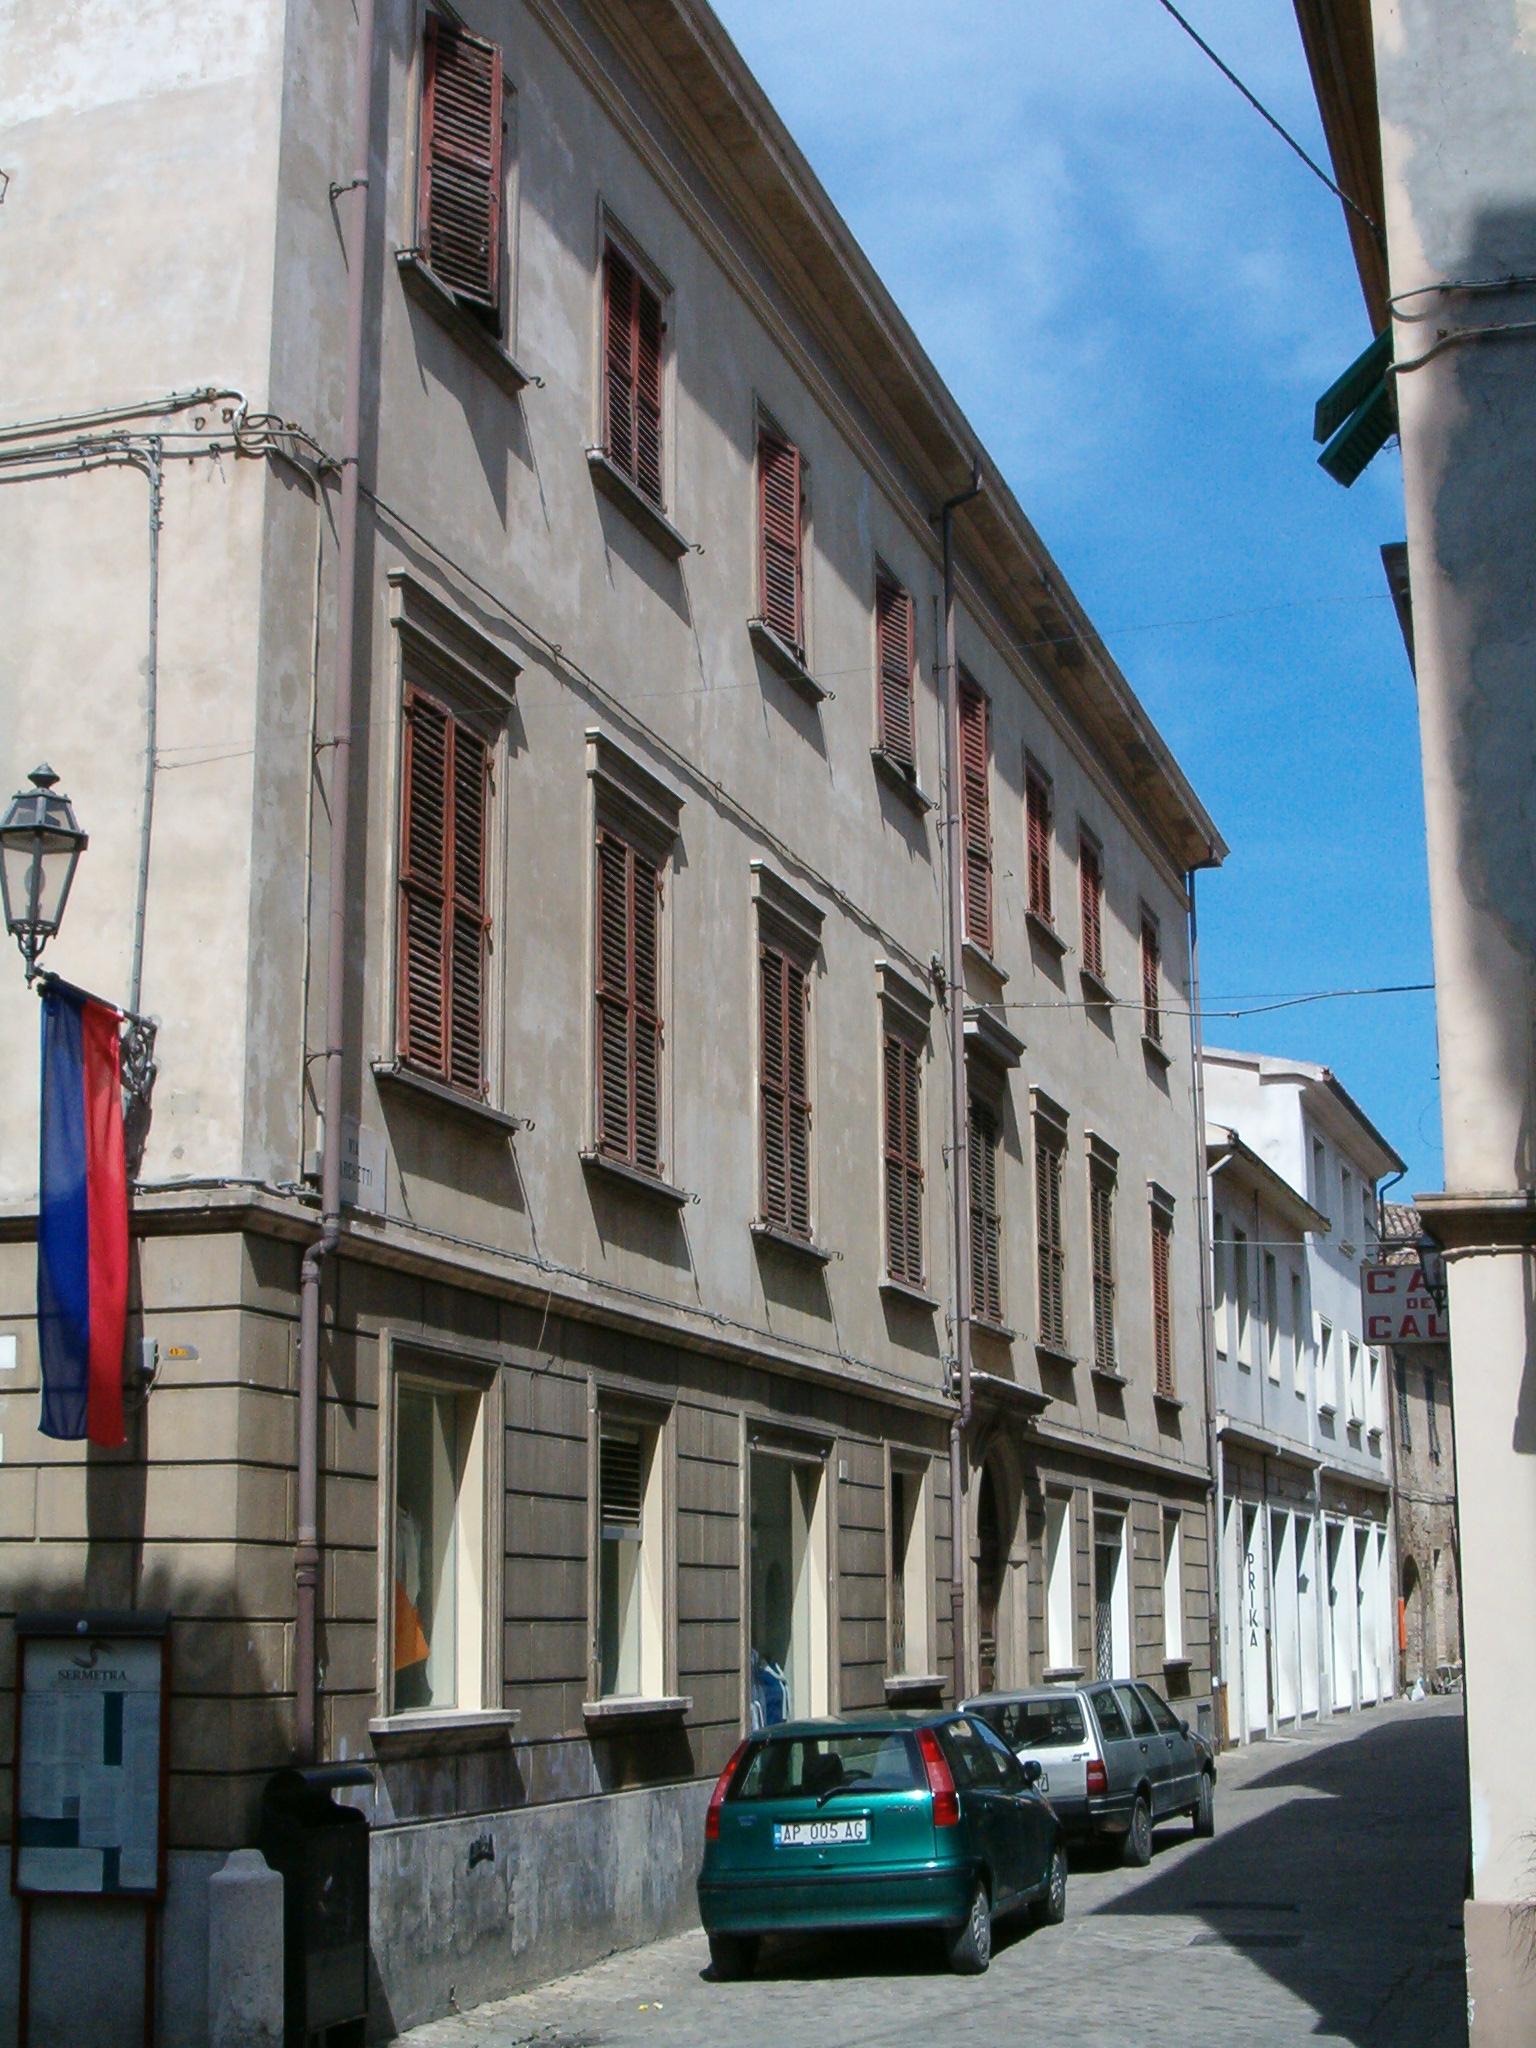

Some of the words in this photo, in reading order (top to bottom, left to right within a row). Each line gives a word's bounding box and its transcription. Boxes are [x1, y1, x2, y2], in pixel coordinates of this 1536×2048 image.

[1367, 1269, 1425, 1293] CA
[1407, 1298, 1432, 1309] DE
[1368, 1314, 1448, 1338] CAL
[1247, 1552, 1258, 1647] PRIKA
[58, 1670, 127, 1681] SERMETRA
[783, 1825, 801, 1841] AP
[810, 1823, 838, 1840] 005
